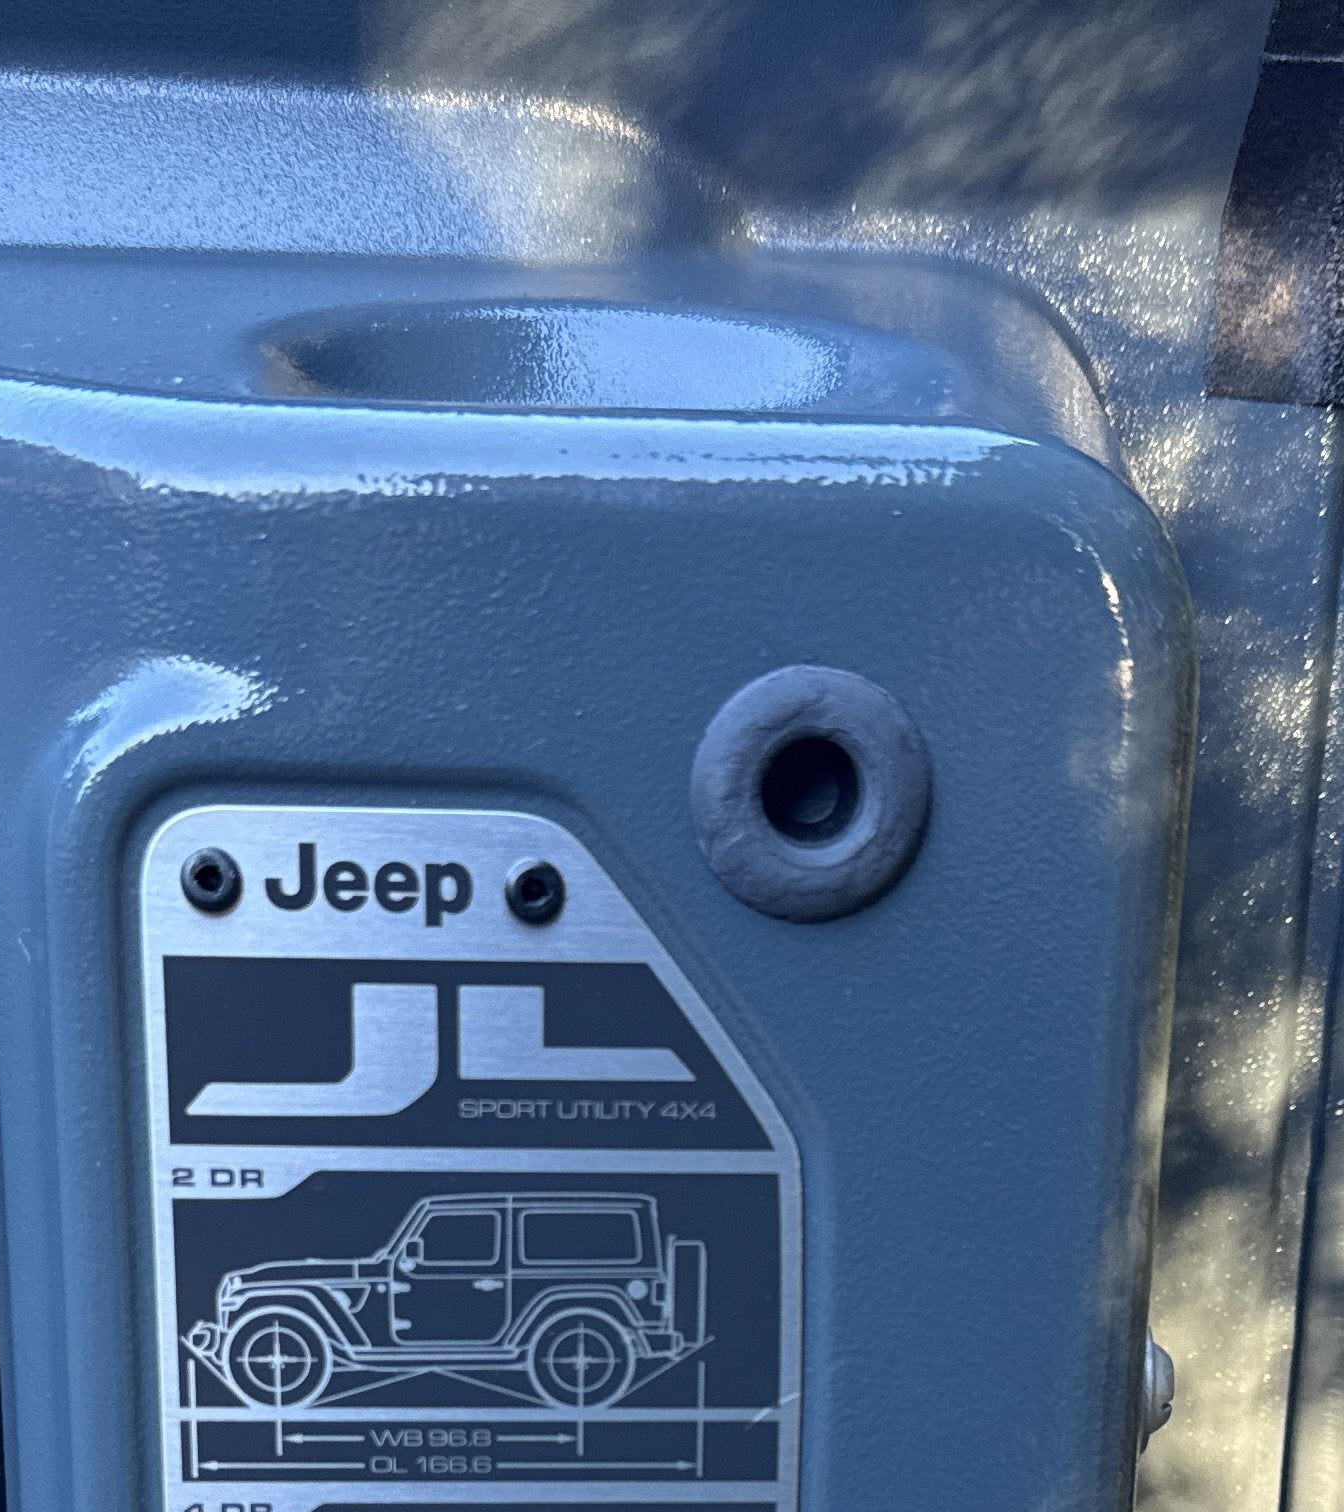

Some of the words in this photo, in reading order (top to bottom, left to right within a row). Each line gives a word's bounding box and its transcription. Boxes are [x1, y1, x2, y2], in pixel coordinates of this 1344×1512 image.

[265, 842, 473, 925] Jeep
[185, 982, 697, 1116] JL
[459, 1099, 550, 1119] SPORT
[557, 1100, 655, 1120] UTILITY
[660, 1101, 717, 1120] 4X4
[172, 1168, 196, 1188] 2
[211, 1168, 264, 1189] DR
[370, 1430, 422, 1447] WB
[428, 1430, 492, 1448] 96.8
[370, 1456, 407, 1473] OL
[416, 1456, 493, 1474] 166.6
